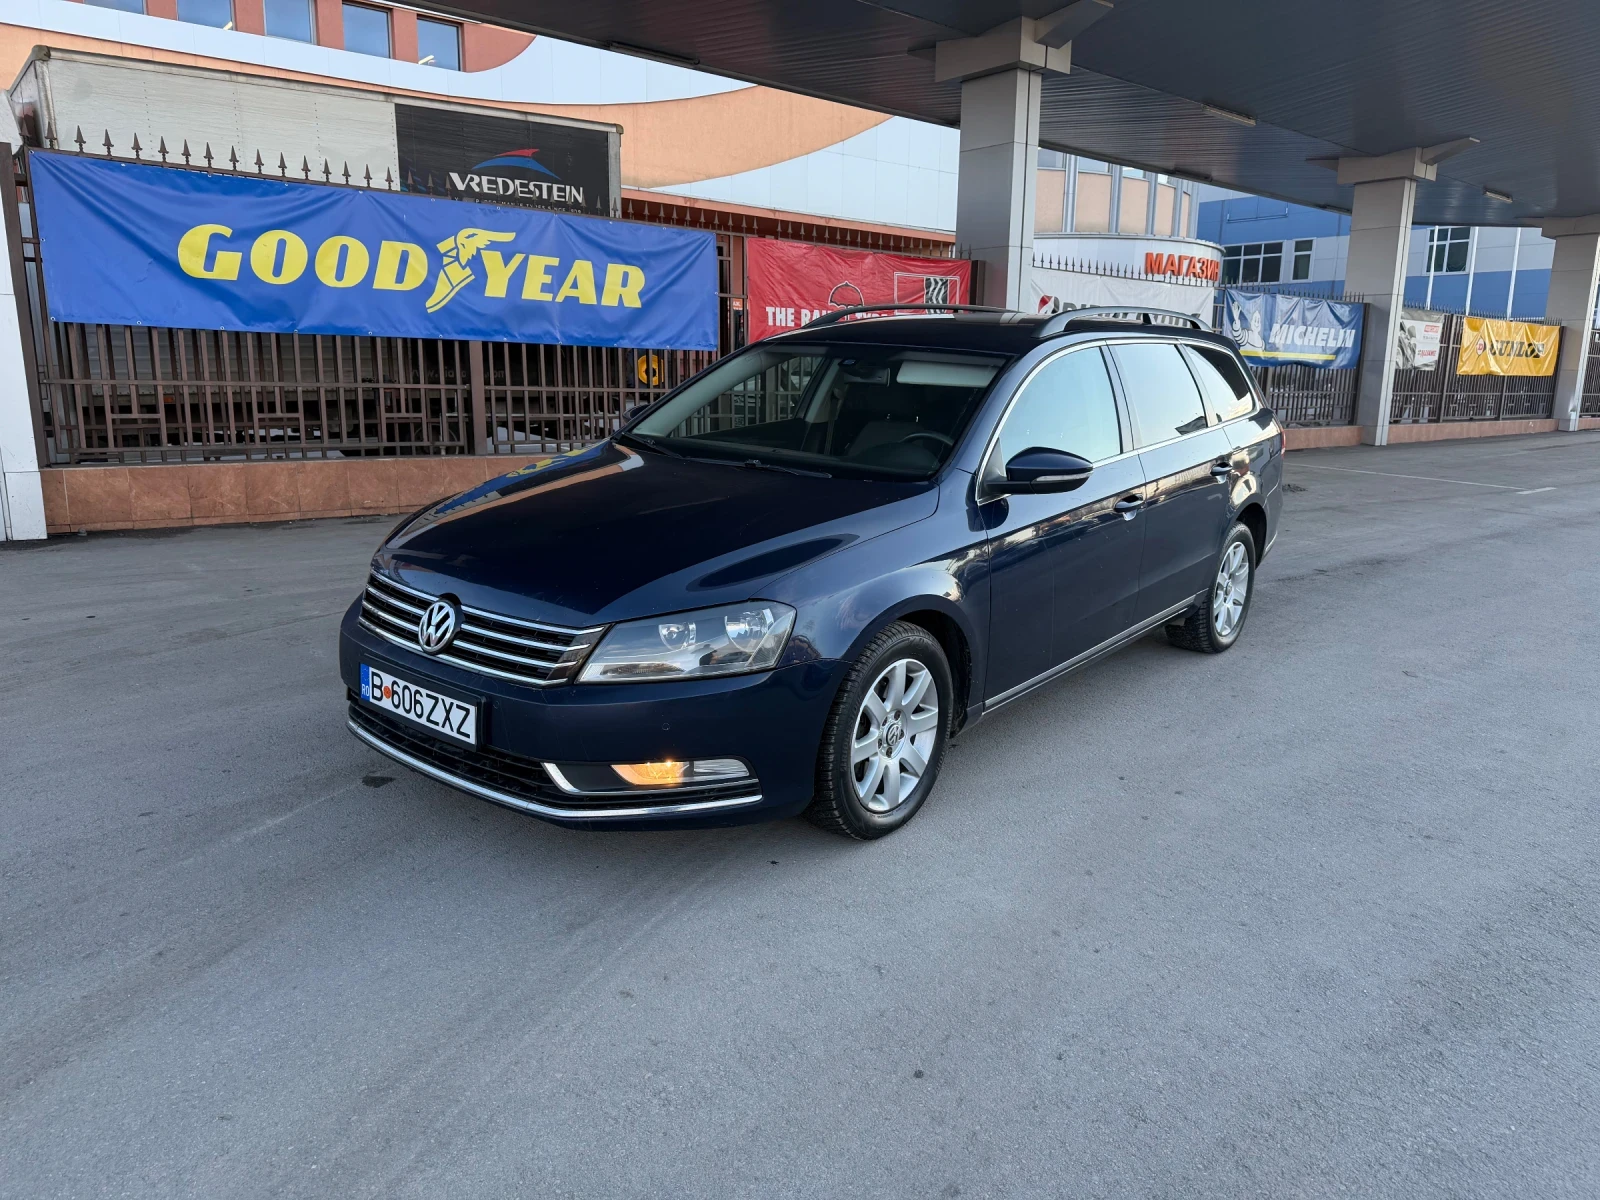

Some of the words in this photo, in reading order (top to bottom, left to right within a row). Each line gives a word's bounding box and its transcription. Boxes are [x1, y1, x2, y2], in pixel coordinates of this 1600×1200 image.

[449, 172, 583, 204] VREDESTEIN
[1144, 252, 1220, 282] МАГАЗИН
[766, 307, 795, 327] THE
[801, 309, 832, 327] RAI
[1269, 324, 1356, 348] MICHELIN
[361, 683, 370, 697] RO
